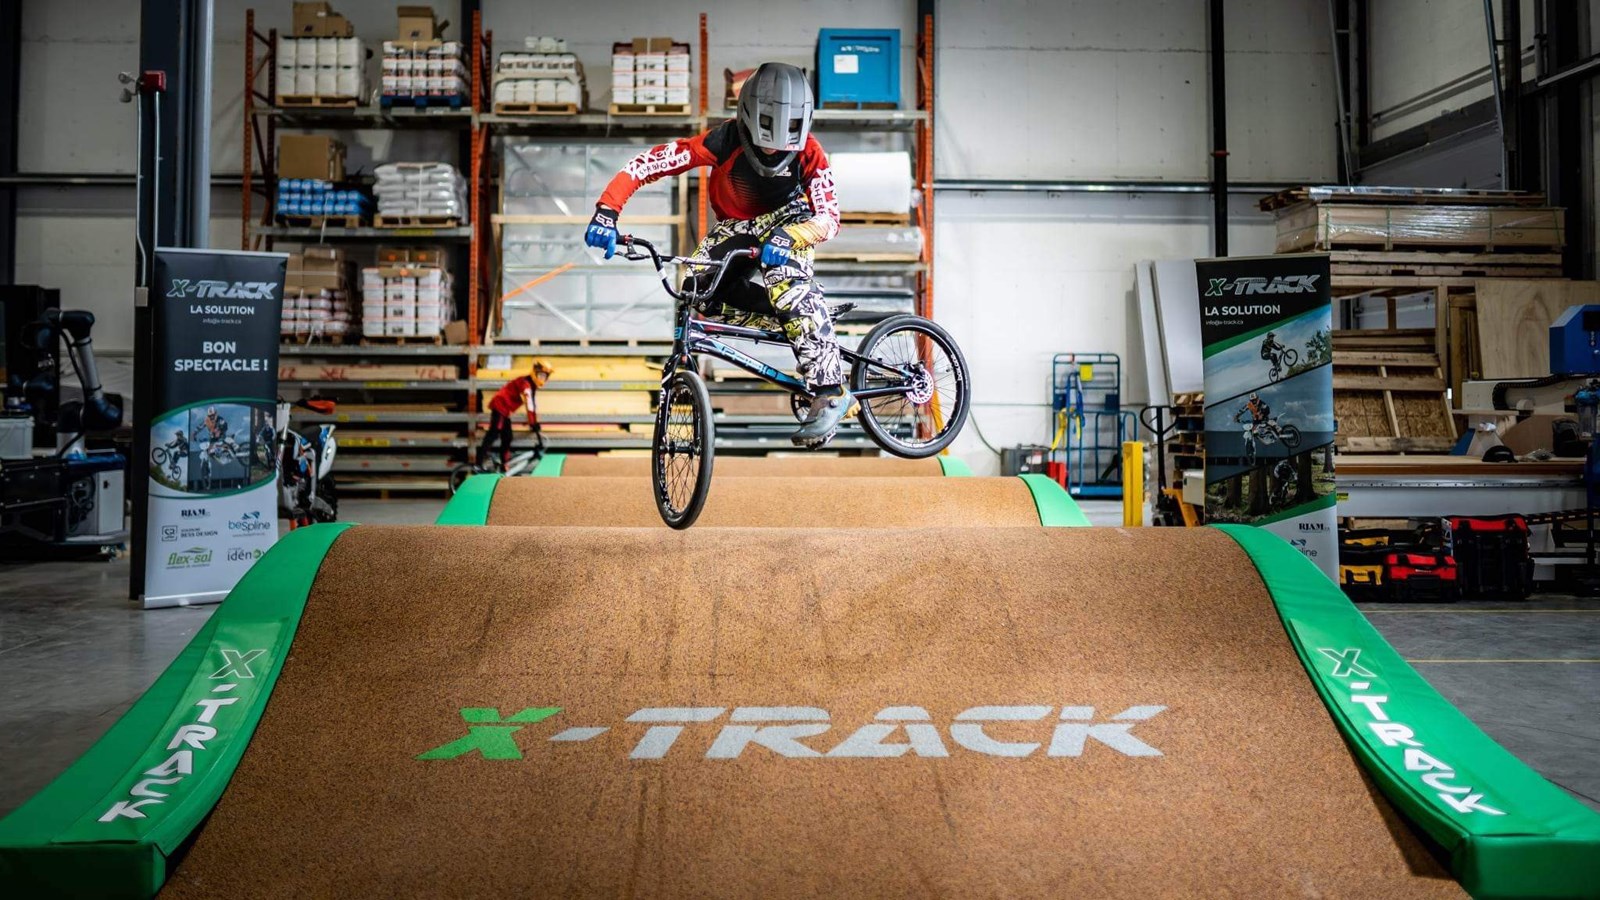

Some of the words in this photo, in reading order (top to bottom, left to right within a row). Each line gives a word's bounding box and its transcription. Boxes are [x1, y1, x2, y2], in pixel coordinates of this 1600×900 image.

[590, 226, 611, 237] FOX
[166, 279, 278, 299] X-TRACK
[1204, 274, 1320, 296] X-TRACK
[190, 305, 203, 314] LA
[204, 305, 255, 315] SOLUTION
[1205, 306, 1219, 316] LA
[1221, 304, 1280, 315] SOLUTION
[203, 341, 237, 354] BON
[174, 359, 260, 372] SPECTACLE
[263, 359, 268, 371] !
[228, 520, 270, 532] beSpline
[167, 549, 213, 565] flex-sol
[97, 649, 268, 822] X-TRACK
[414, 705, 1169, 760] X-TRACK
[1317, 648, 1508, 816] X-TRACK
